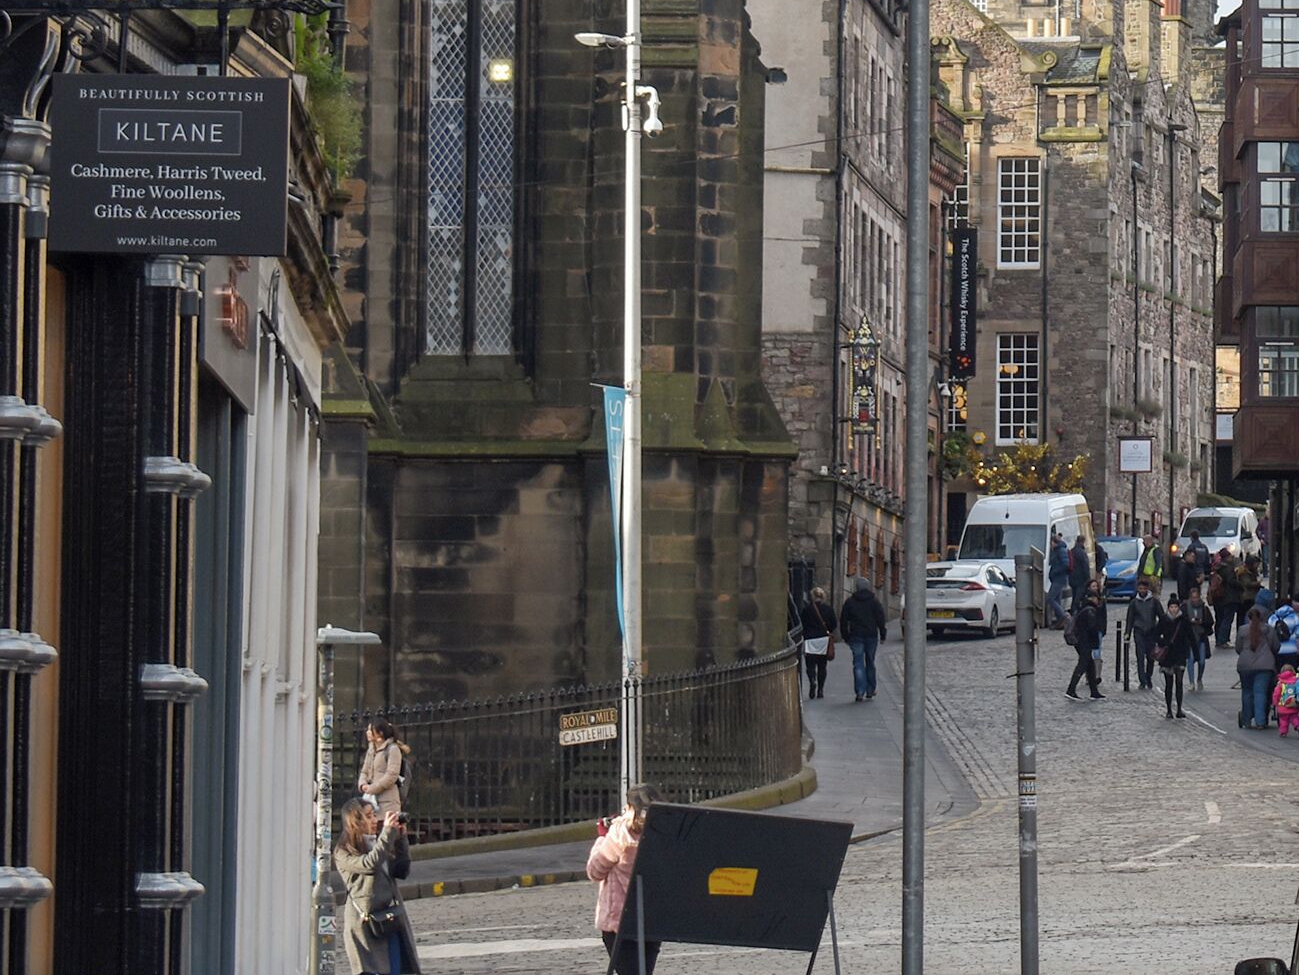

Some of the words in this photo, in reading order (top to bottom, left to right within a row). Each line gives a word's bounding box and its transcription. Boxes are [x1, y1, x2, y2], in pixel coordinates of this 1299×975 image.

[79, 88, 180, 101] BEAUTIFULLY
[186, 90, 265, 102] SCOTTISH
[116, 122, 224, 142] KILTANE
[71, 163, 154, 180] Cashmere,
[157, 165, 208, 180] Harris
[211, 166, 267, 182] Tweed,
[111, 184, 146, 199] Fine
[149, 185, 226, 201] Woollens,
[94, 204, 132, 218] Gifts
[135, 205, 148, 219] &
[150, 206, 241, 221] Accessories
[116, 234, 217, 248] www.kiltane.com
[961, 238, 970, 253] The
[961, 254, 970, 279] Scotch
[959, 280, 969, 308] Whisky
[959, 310, 969, 351] Experience
[562, 714, 589, 729] ROYAL
[596, 711, 615, 723] MILE
[563, 726, 615, 743] CASTLEHILL
